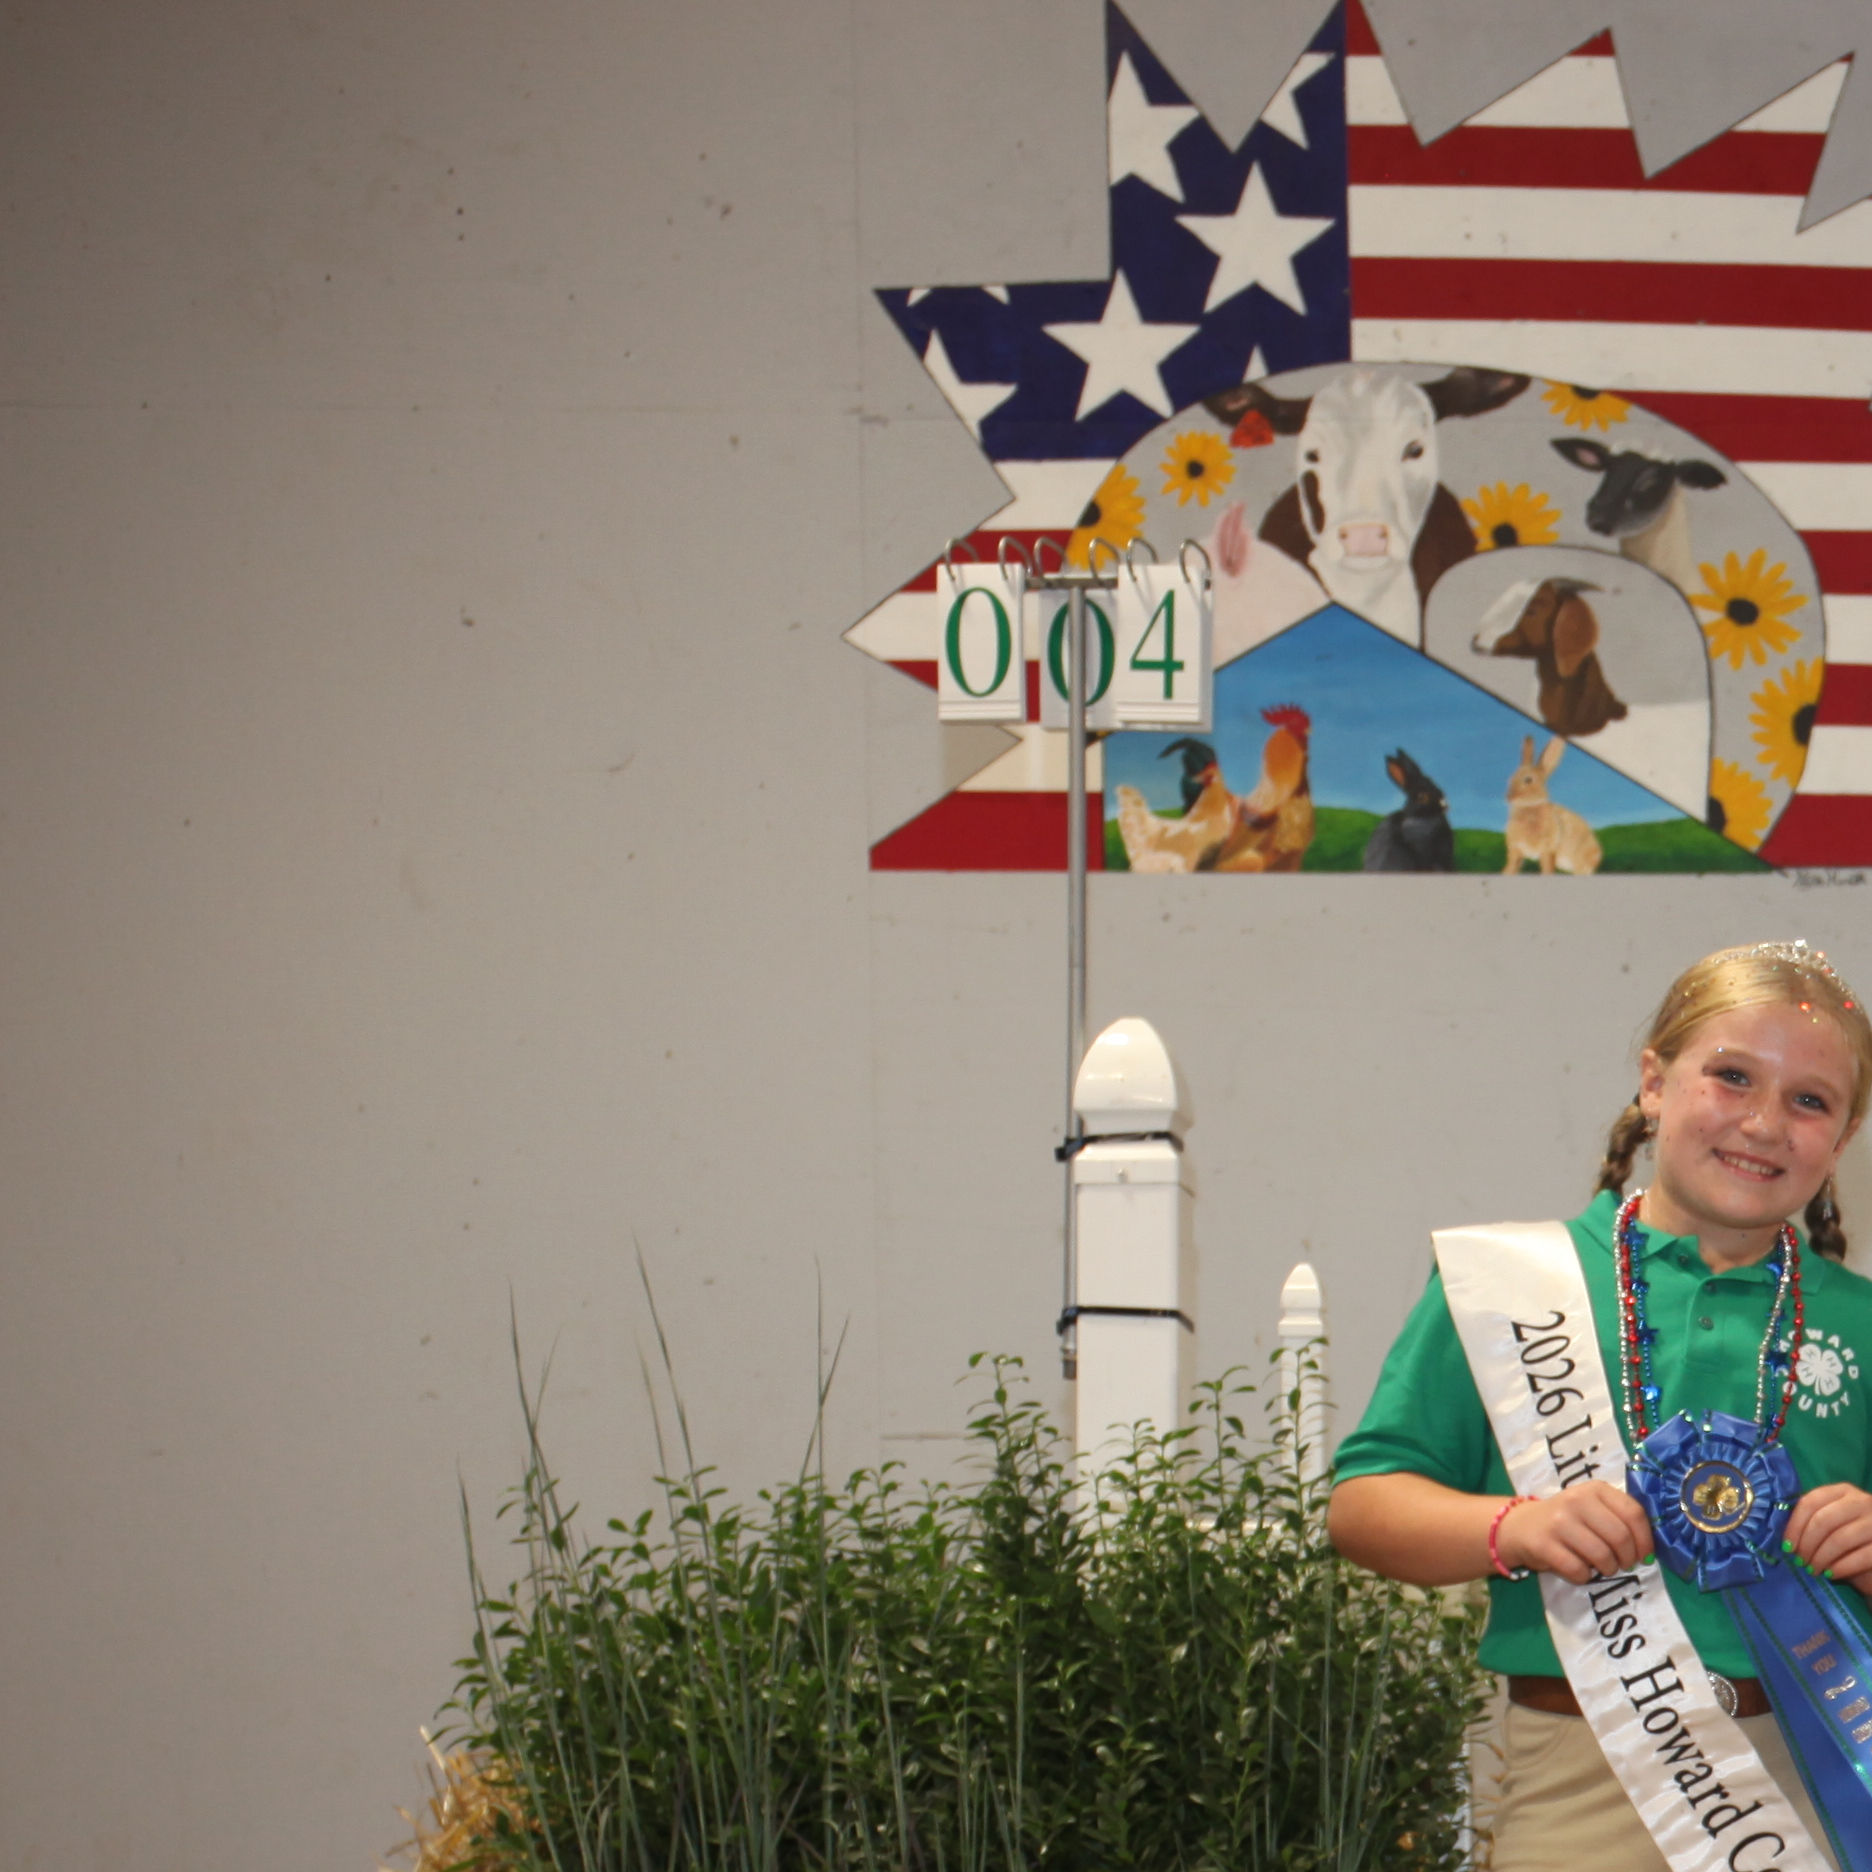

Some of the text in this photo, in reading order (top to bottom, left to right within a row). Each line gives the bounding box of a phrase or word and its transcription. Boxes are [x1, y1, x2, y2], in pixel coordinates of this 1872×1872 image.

[1511, 1310, 1584, 1417] 2026
[1546, 1414, 1601, 1490] Lit
[1619, 1655, 1764, 1840] Howard
